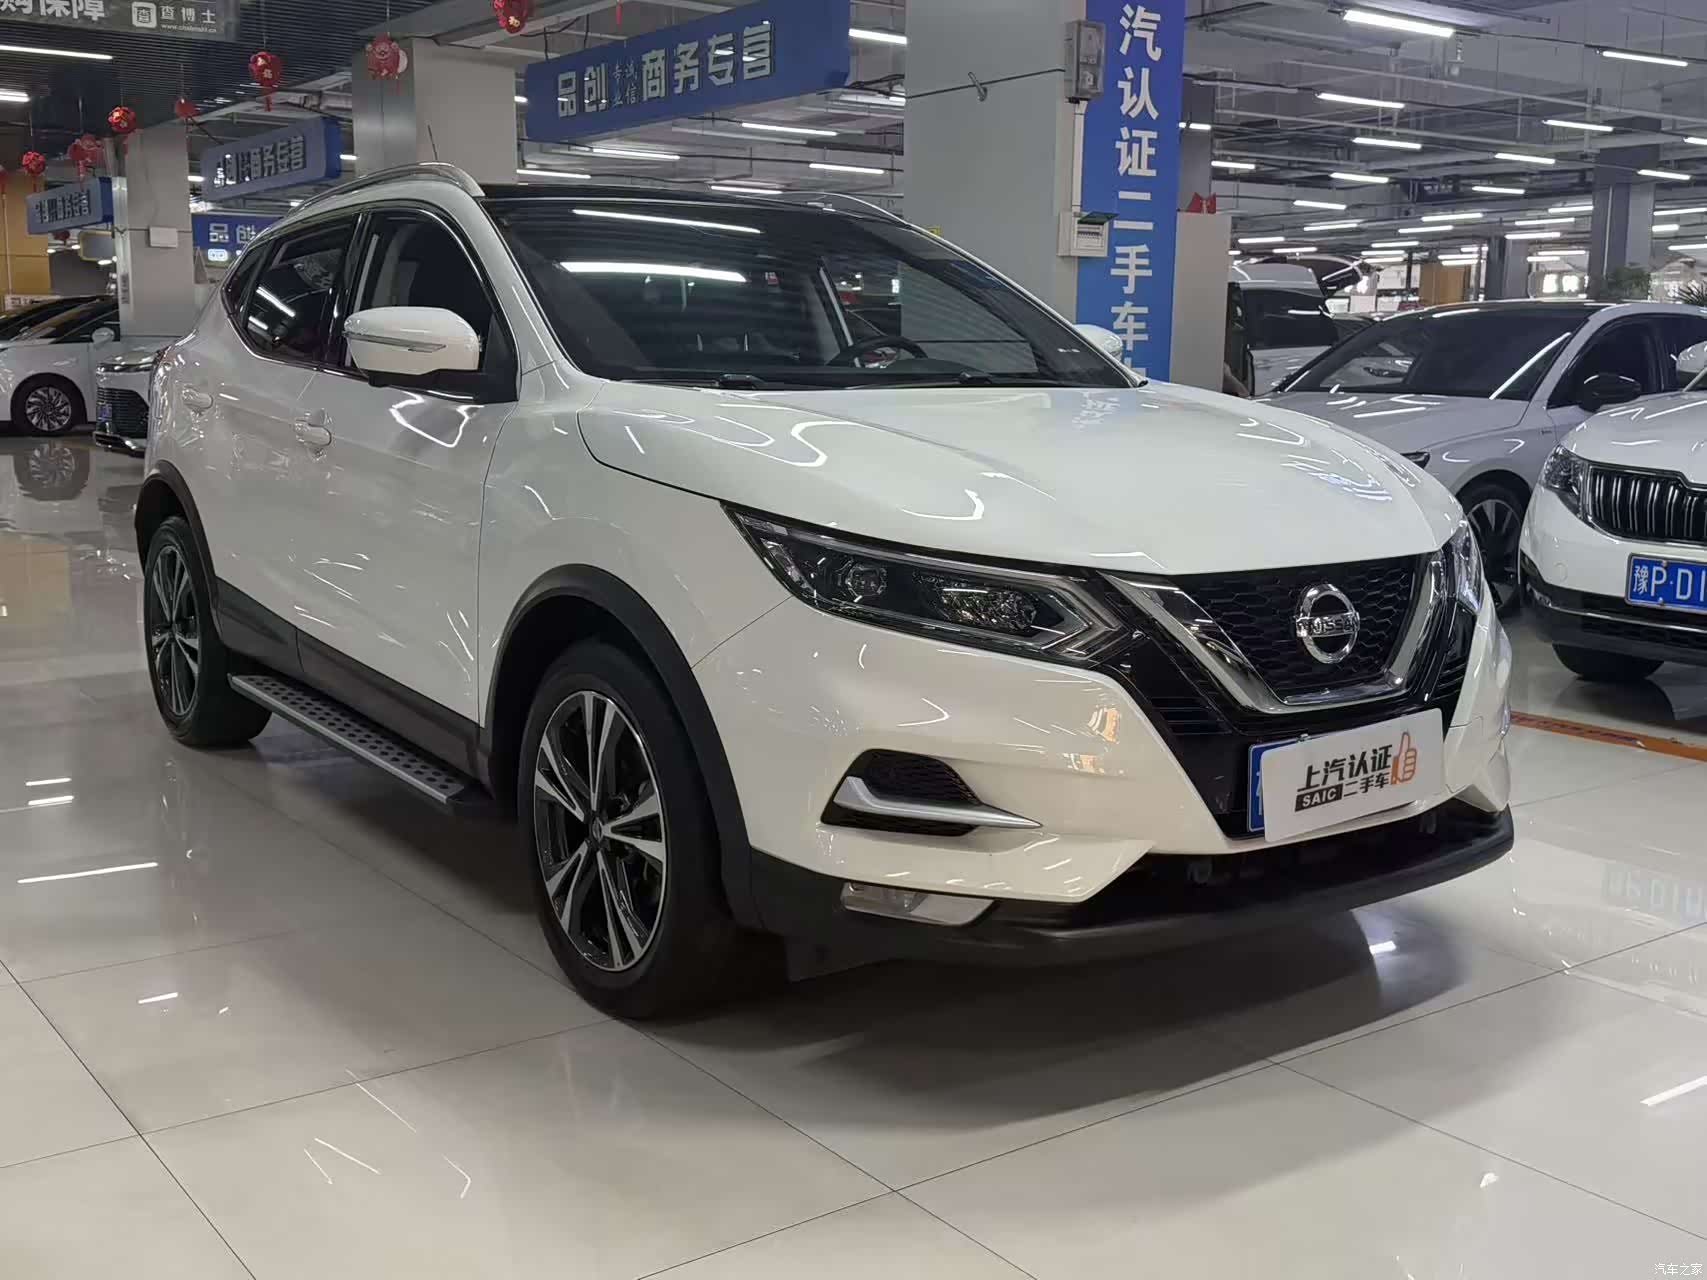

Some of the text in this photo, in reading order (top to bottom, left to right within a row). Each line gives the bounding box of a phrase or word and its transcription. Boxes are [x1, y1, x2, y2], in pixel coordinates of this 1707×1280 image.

[160, 5, 216, 24] 查博士
[642, 22, 773, 101] 商务专营
[558, 65, 608, 118] 品创
[1110, 4, 1162, 376] 汽认证二手车
[1297, 744, 1393, 792] 上汽认证
[1344, 771, 1390, 798] 二手车
[1302, 788, 1338, 808] SAIC
